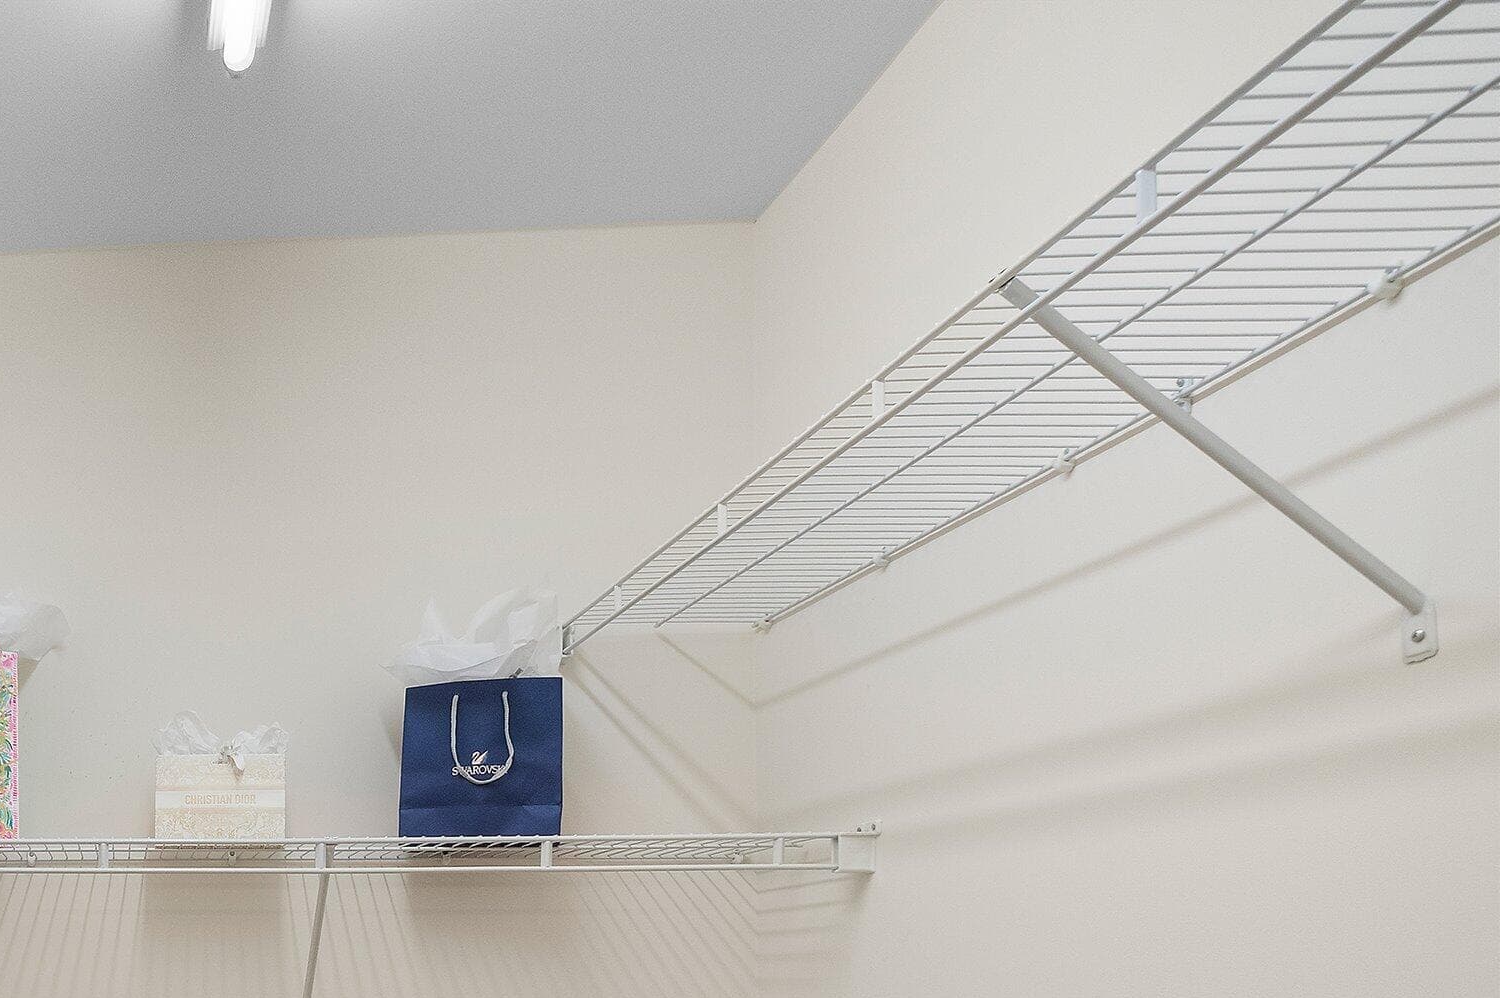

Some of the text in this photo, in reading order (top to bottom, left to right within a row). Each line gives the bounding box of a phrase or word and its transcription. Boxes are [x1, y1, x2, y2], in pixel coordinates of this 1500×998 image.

[451, 764, 508, 776] SWAROVSK
[184, 794, 256, 805] CHRISTIAN DIOR
